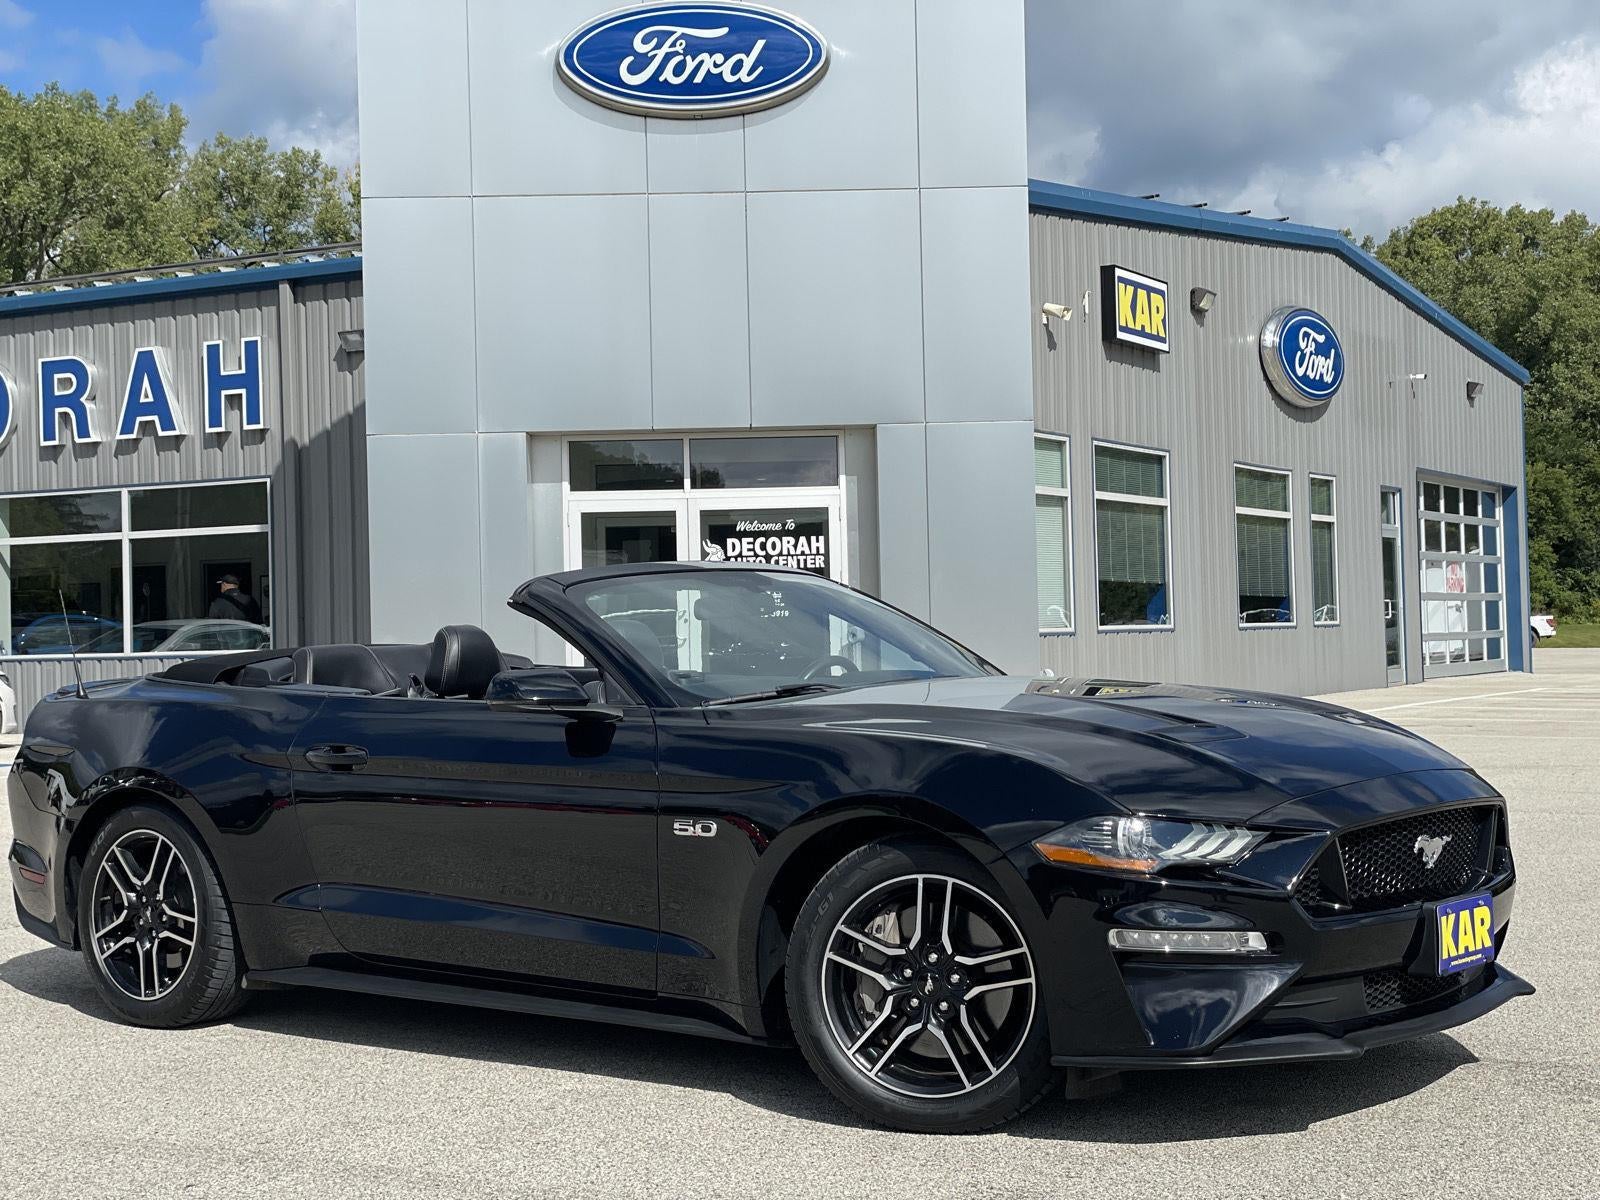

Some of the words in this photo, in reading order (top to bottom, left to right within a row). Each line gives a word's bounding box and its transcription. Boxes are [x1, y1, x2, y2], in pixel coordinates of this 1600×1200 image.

[619, 25, 766, 85] Ford
[1118, 282, 1166, 337] KAR
[1295, 326, 1334, 383] Ford
[0, 336, 265, 446] RAH
[726, 535, 825, 556] DECORAH
[735, 520, 782, 532] Welcome
[785, 518, 796, 530] To
[770, 555, 825, 568] CENTER
[1441, 905, 1492, 959] KAR
